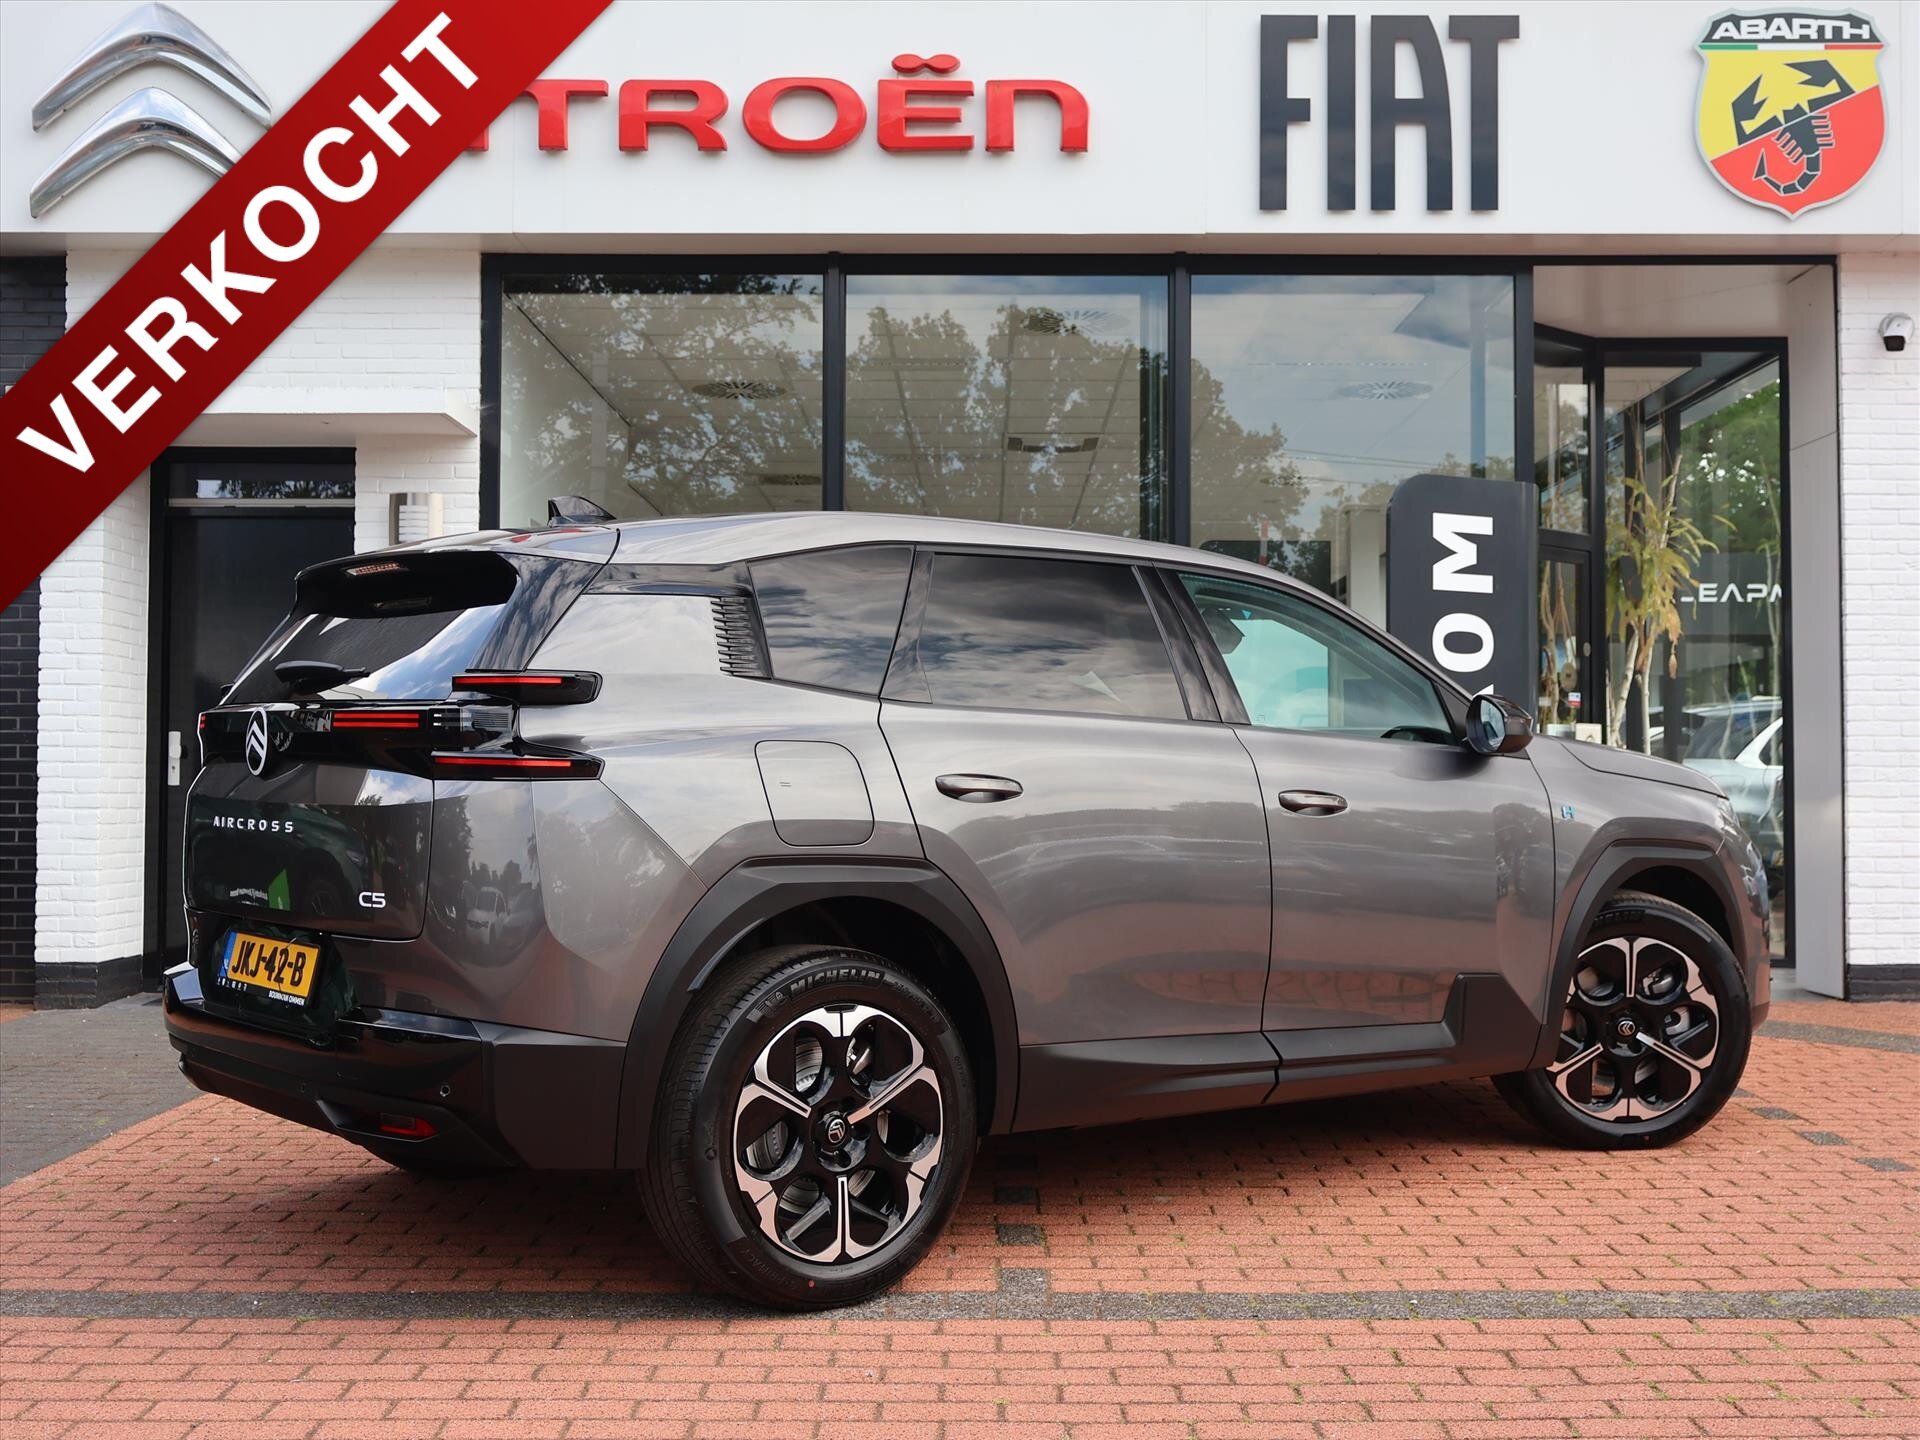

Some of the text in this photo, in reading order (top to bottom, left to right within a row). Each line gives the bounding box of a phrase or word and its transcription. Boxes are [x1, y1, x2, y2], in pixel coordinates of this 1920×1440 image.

[1711, 17, 1872, 41] ABARTH
[1259, 14, 1520, 212] FIAT
[1432, 512, 1494, 700] OM
[213, 815, 294, 833] AIRCROSS
[358, 891, 386, 909] C5
[231, 940, 307, 987] JKJ-42-B
[790, 968, 882, 993] MICHELIN
